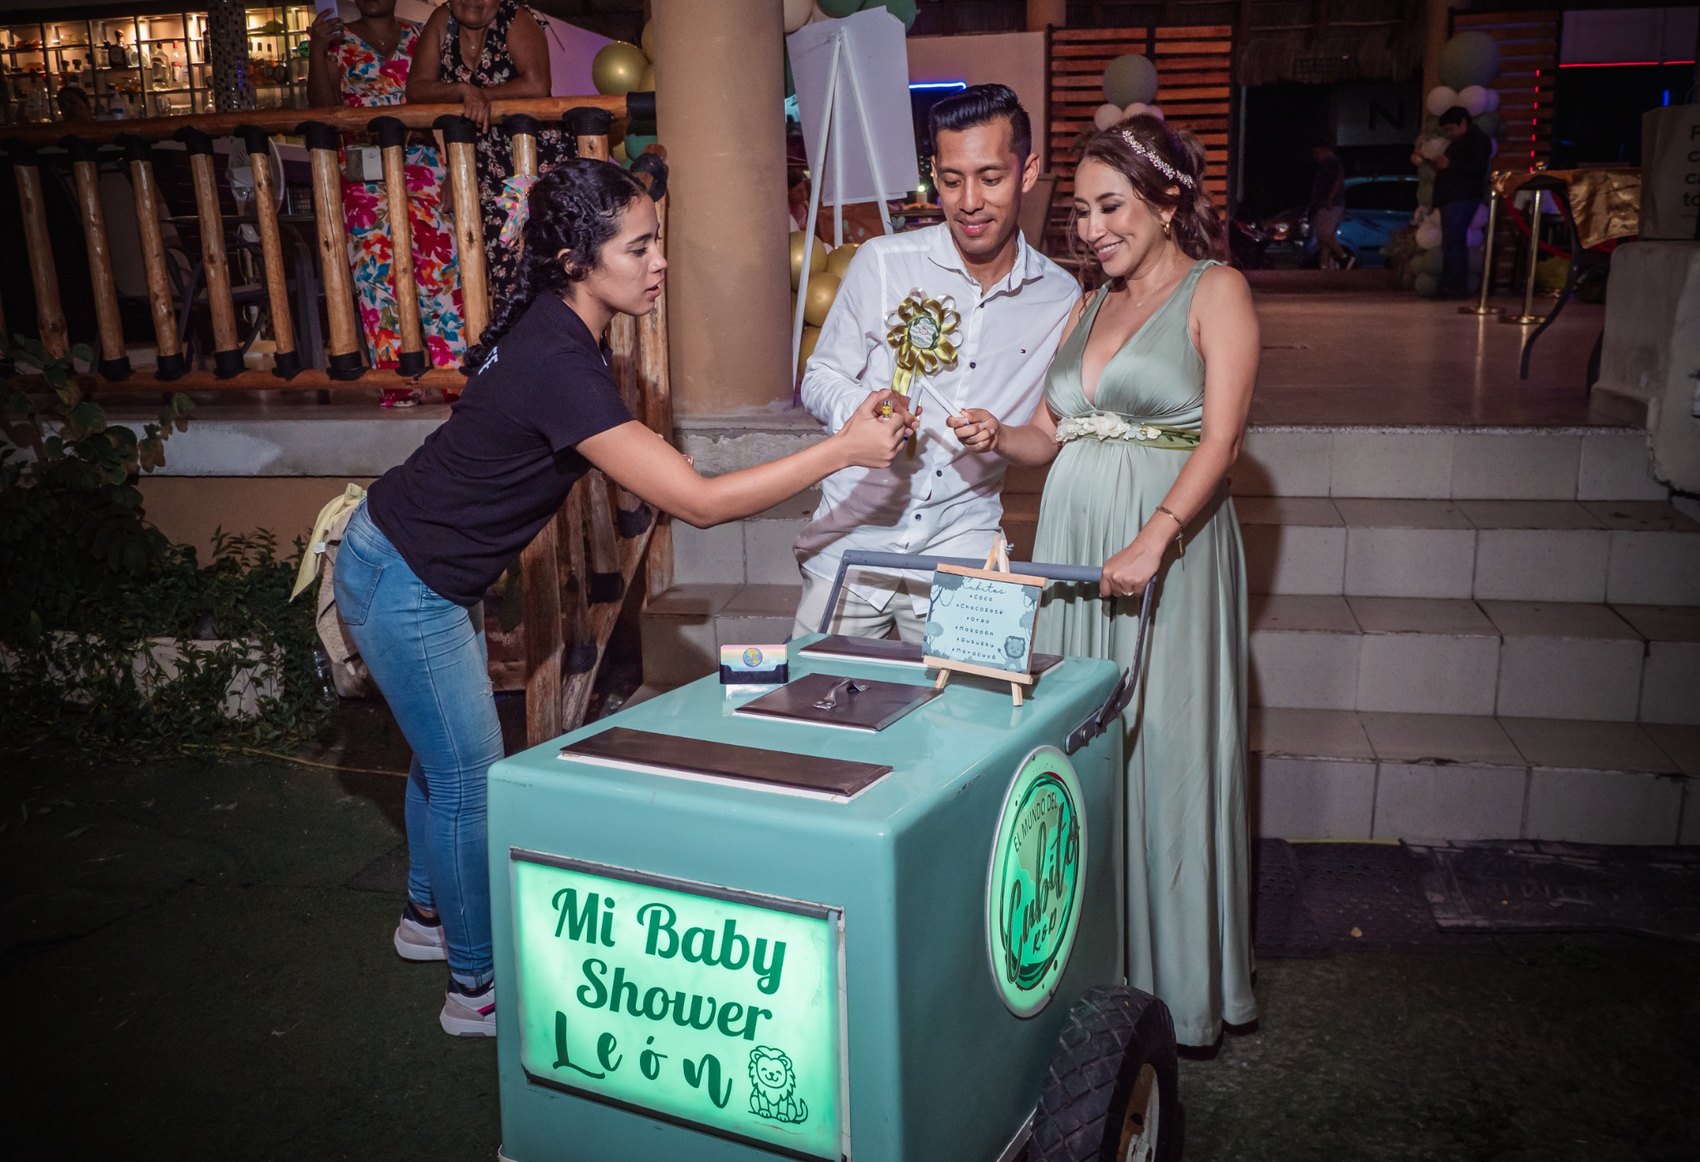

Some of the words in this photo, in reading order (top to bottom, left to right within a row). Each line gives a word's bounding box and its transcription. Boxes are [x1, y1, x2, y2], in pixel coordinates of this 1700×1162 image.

[1013, 832, 1023, 853] EL
[1021, 797, 1046, 839] MUNDO
[1047, 791, 1058, 812] DEL
[551, 887, 616, 948] Mi
[636, 902, 787, 995] Baby
[576, 957, 773, 1042] Shower
[552, 1010, 733, 1109] León
